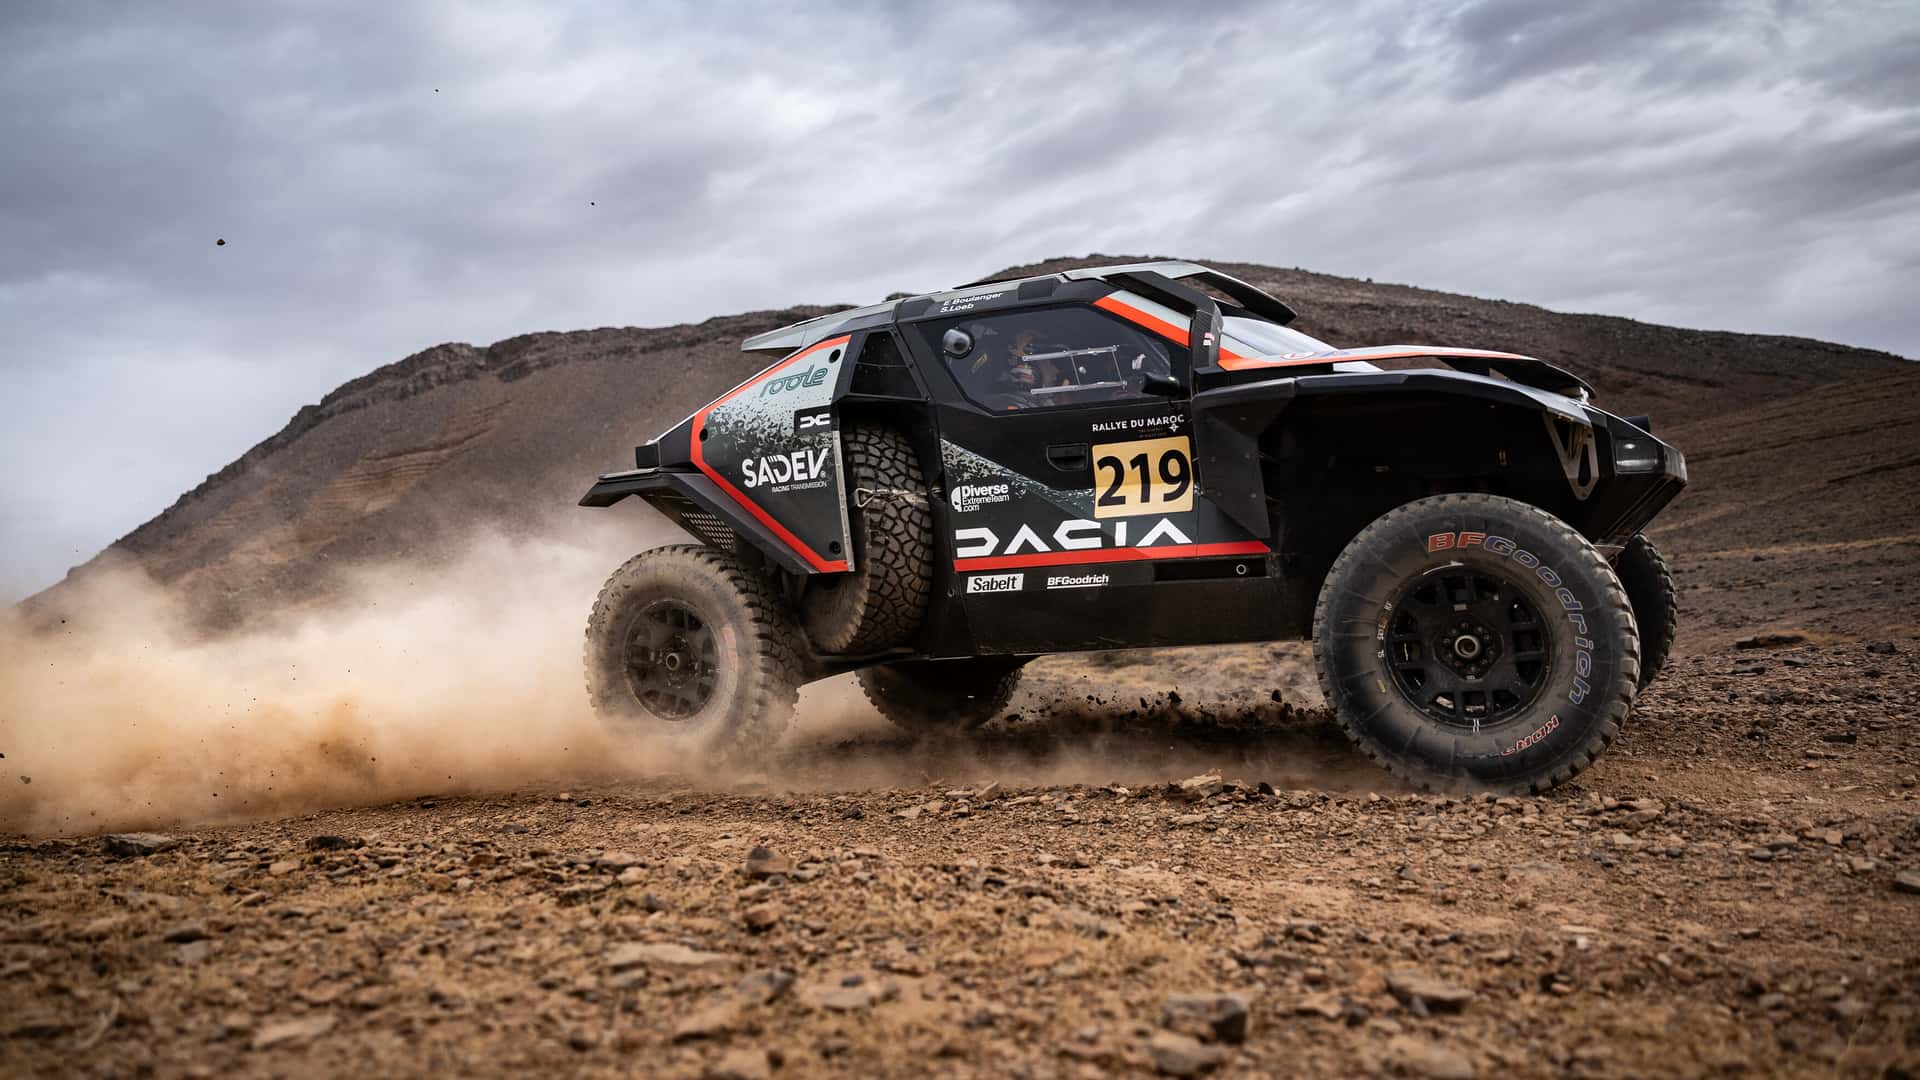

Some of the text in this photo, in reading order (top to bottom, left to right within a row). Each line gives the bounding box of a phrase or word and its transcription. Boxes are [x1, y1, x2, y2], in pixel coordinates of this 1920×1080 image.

[1092, 420, 1128, 432] RALLYE
[1130, 419, 1144, 429] DU
[1147, 414, 1185, 427] MAROC
[1097, 449, 1191, 507] 219
[961, 484, 1009, 498] Diverse
[955, 518, 1193, 558] DACIA
[972, 576, 1018, 592] Sabelt
[1047, 574, 1109, 587] BFGoodrich
[1428, 532, 1594, 704] BFGoodrich
